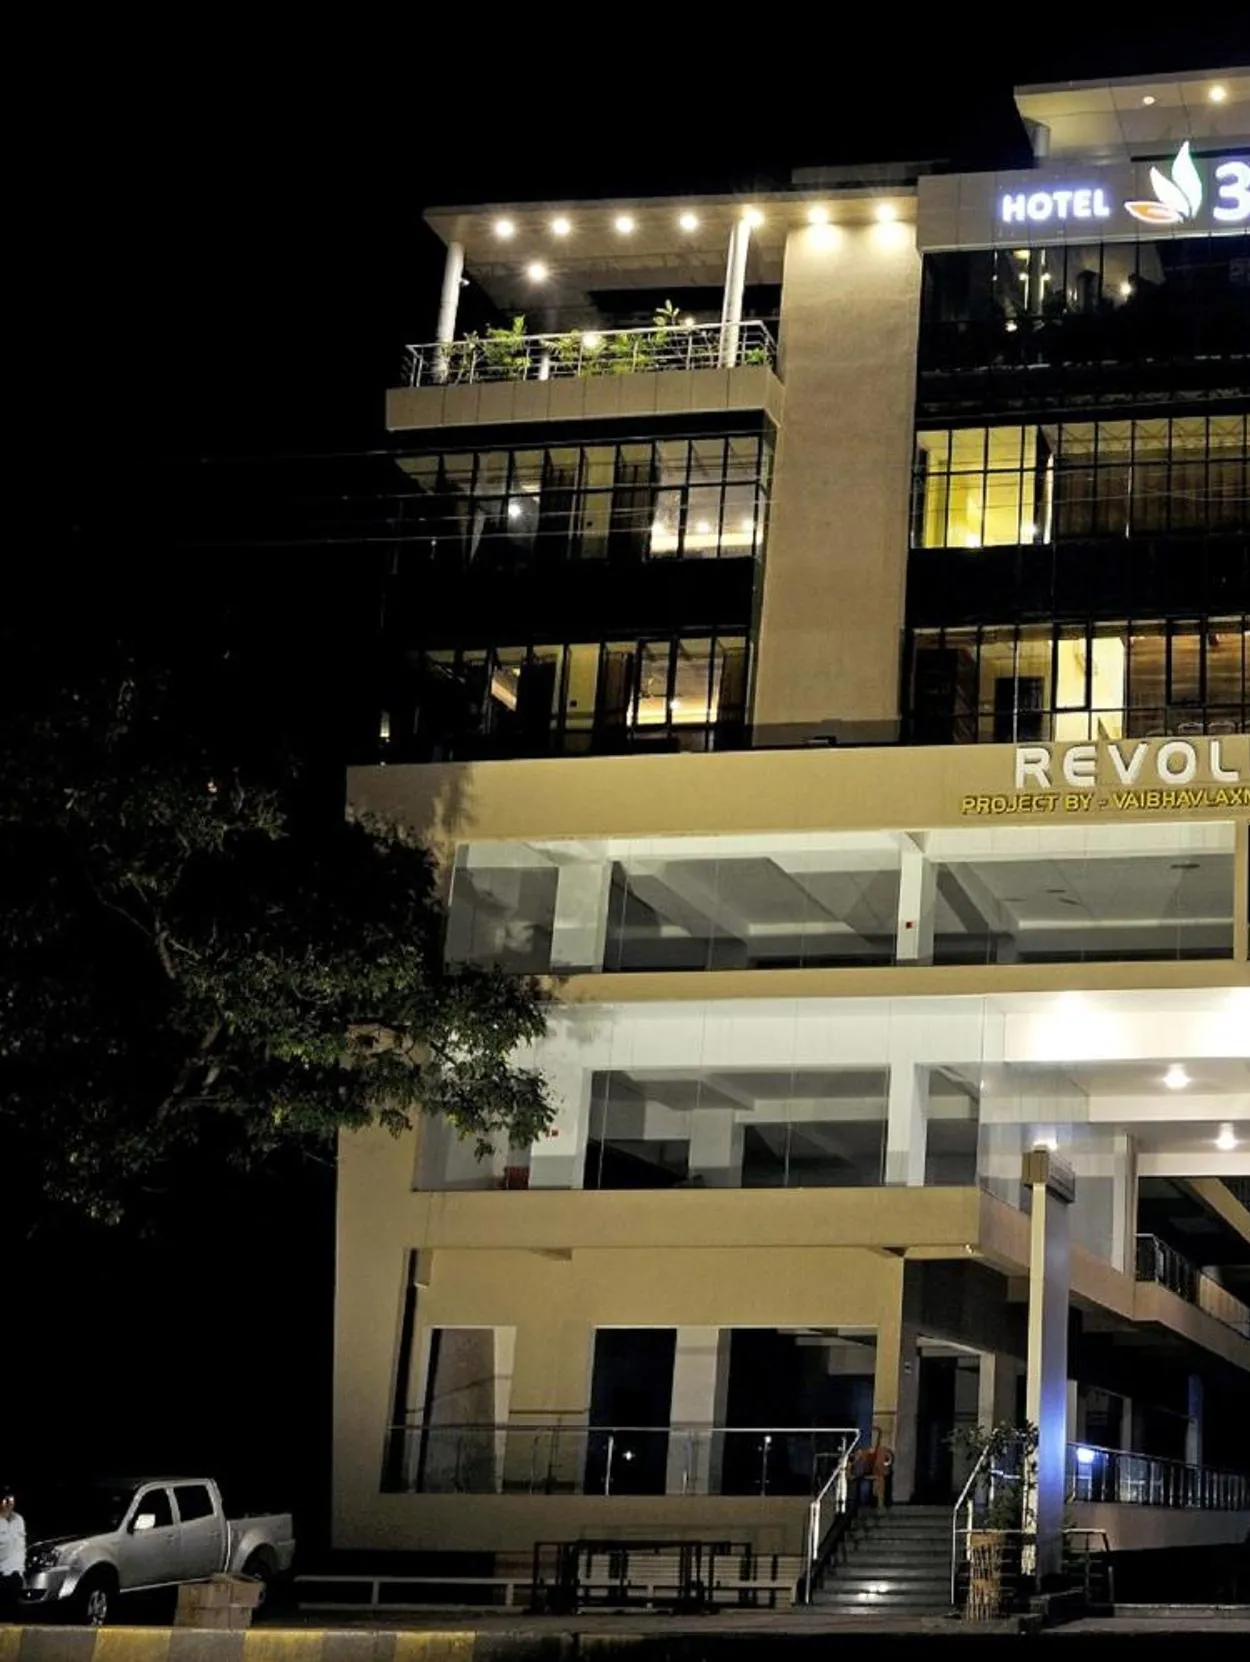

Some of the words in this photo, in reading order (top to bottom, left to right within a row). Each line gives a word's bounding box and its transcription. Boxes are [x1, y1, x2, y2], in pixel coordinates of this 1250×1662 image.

[1002, 189, 1110, 221] HOTEL
[961, 795, 1058, 814] PROJECT
[1064, 793, 1094, 811] BY
